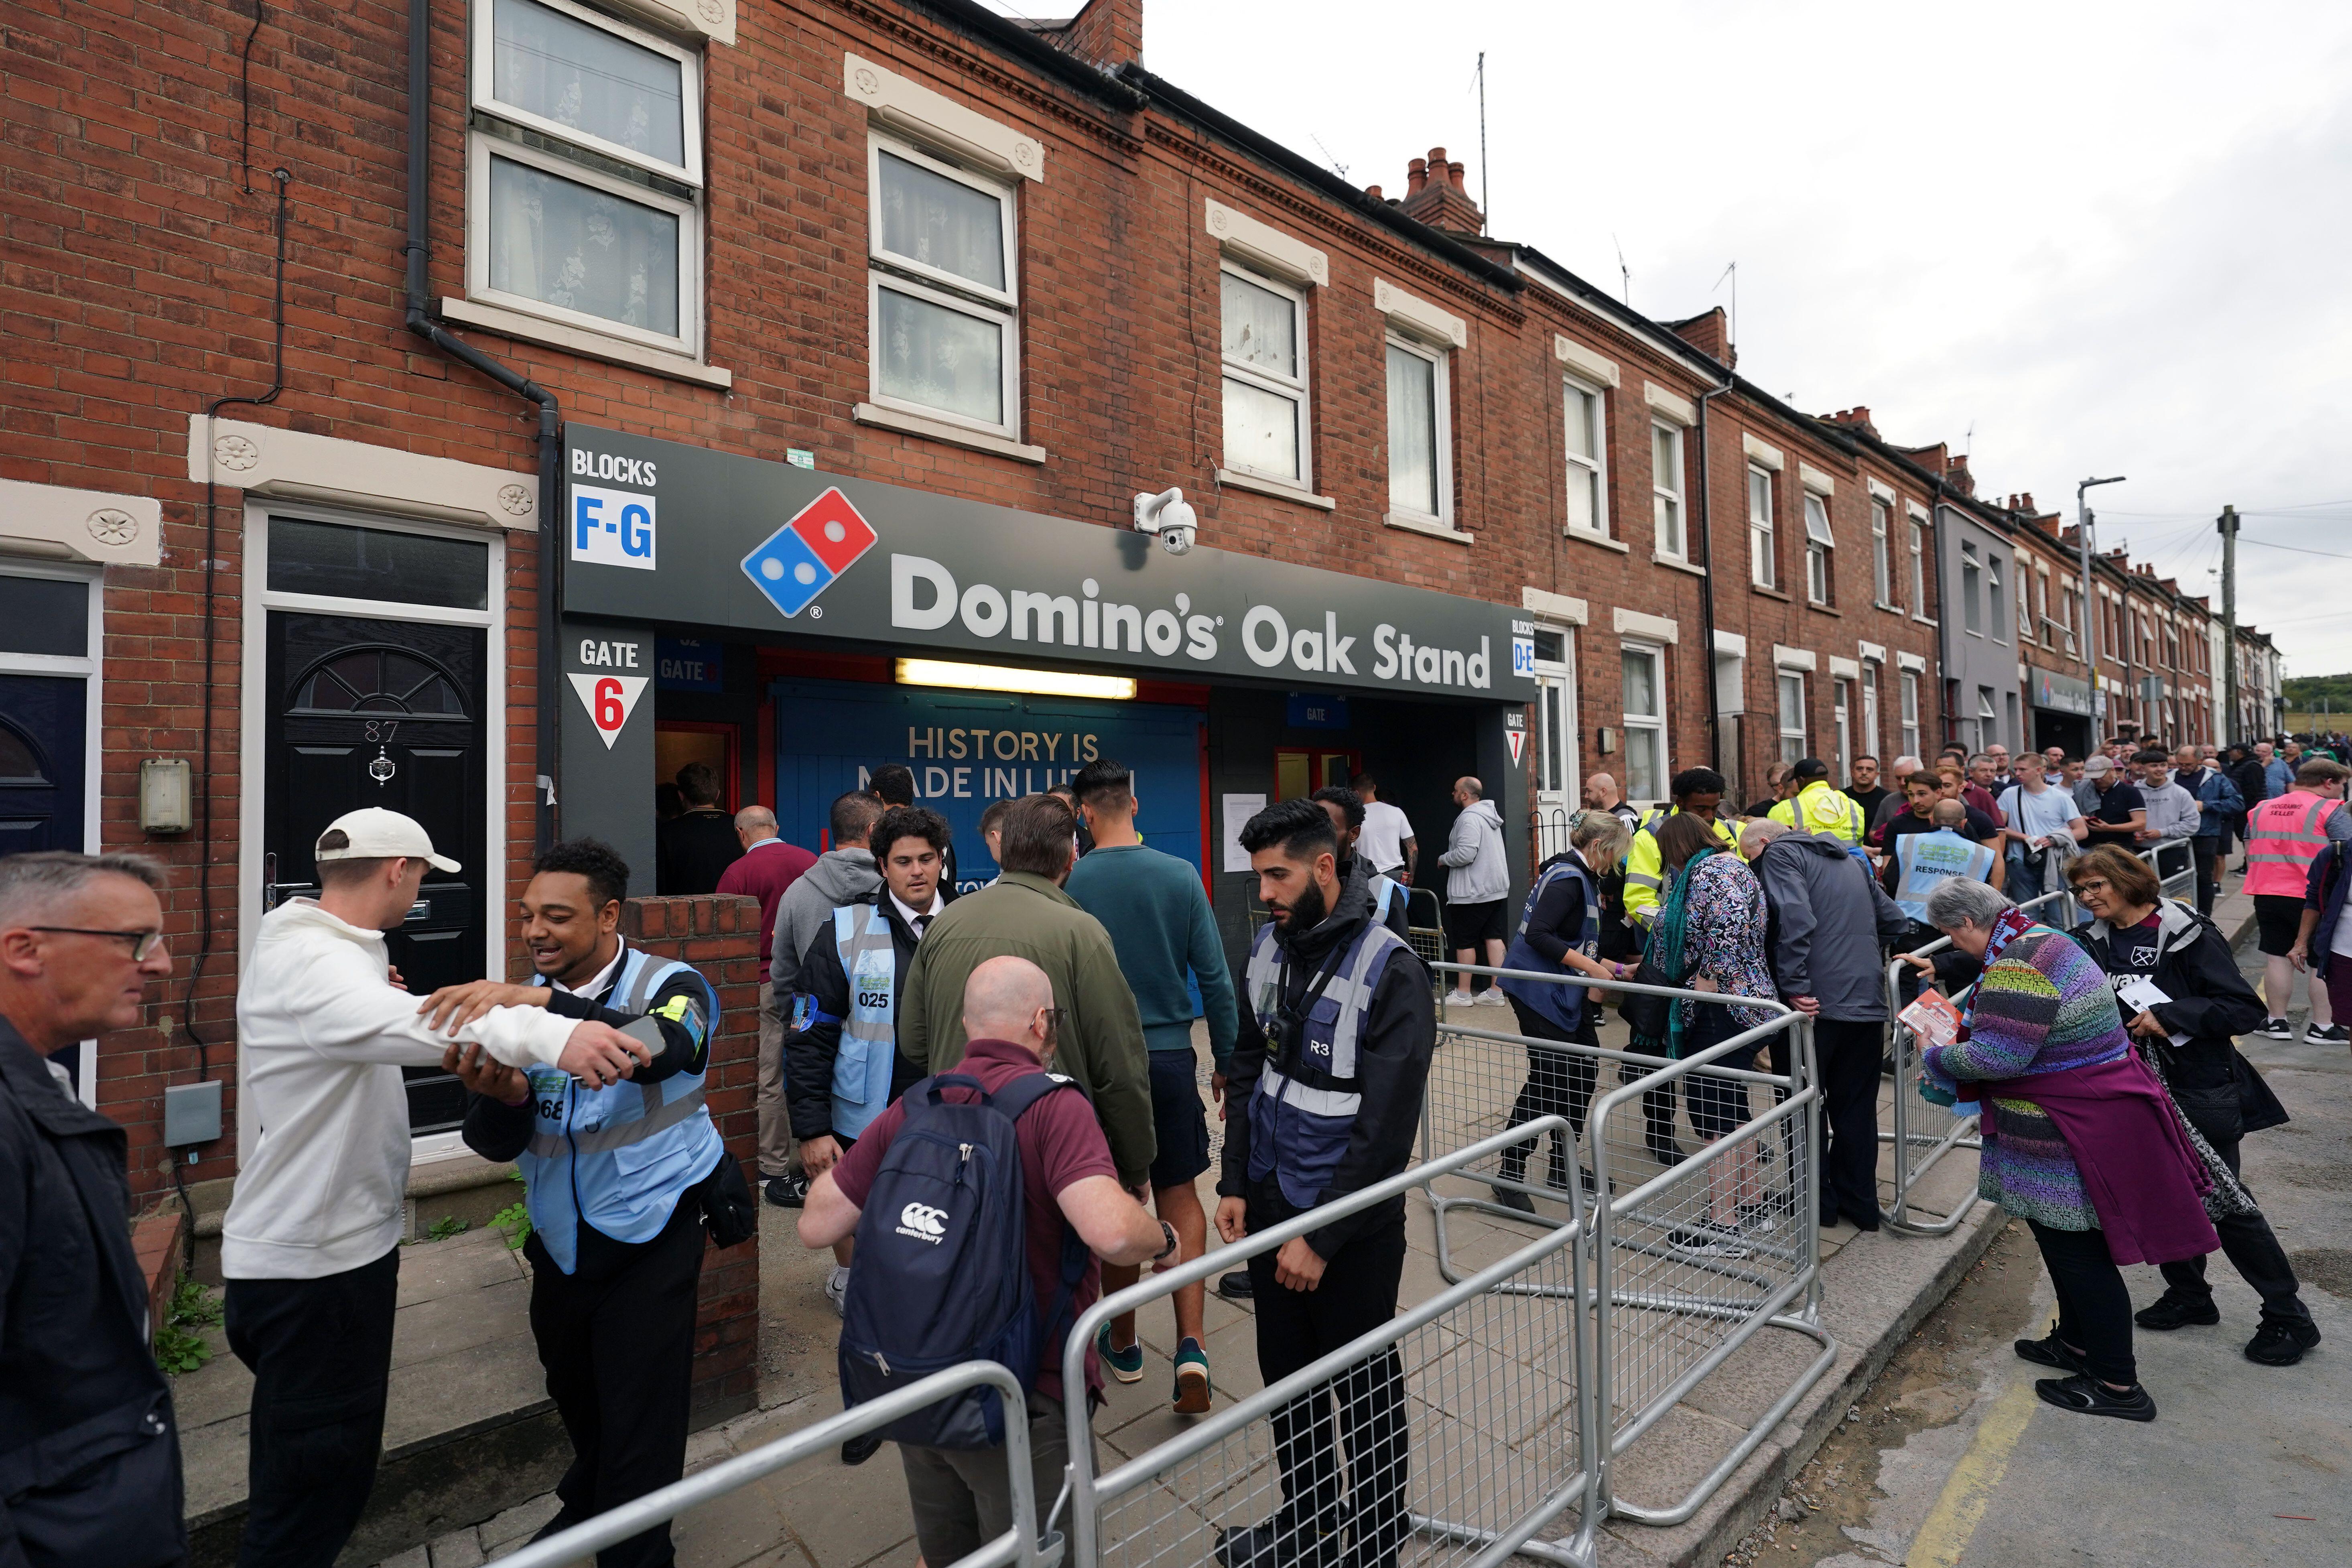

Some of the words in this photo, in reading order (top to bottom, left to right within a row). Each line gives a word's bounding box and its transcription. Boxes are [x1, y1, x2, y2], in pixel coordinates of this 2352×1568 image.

[572, 448, 656, 487] BLOCKS
[577, 496, 651, 558] F-G
[891, 553, 1218, 660] Domino's
[1242, 605, 1358, 675] Oak
[1373, 624, 1491, 689] Stand
[1512, 619, 1534, 636] BLOCKS
[580, 639, 638, 668] GATE
[1515, 644, 1533, 672] D-E
[660, 658, 703, 681] GATE
[595, 678, 624, 731] 6
[1307, 707, 1325, 721] GATE
[365, 721, 399, 742] 87
[1507, 713, 1523, 727] GATE
[908, 727, 1062, 762] HISTORY
[1073, 733, 1099, 763] IS
[1512, 733, 1519, 758] 7
[984, 768, 1017, 798] IN
[1915, 865, 1964, 876] RESPONSE
[859, 992, 889, 1008] 025
[1310, 1039, 1330, 1056] R3
[535, 1099, 564, 1120] 68
[895, 1227, 943, 1245] canterbury
